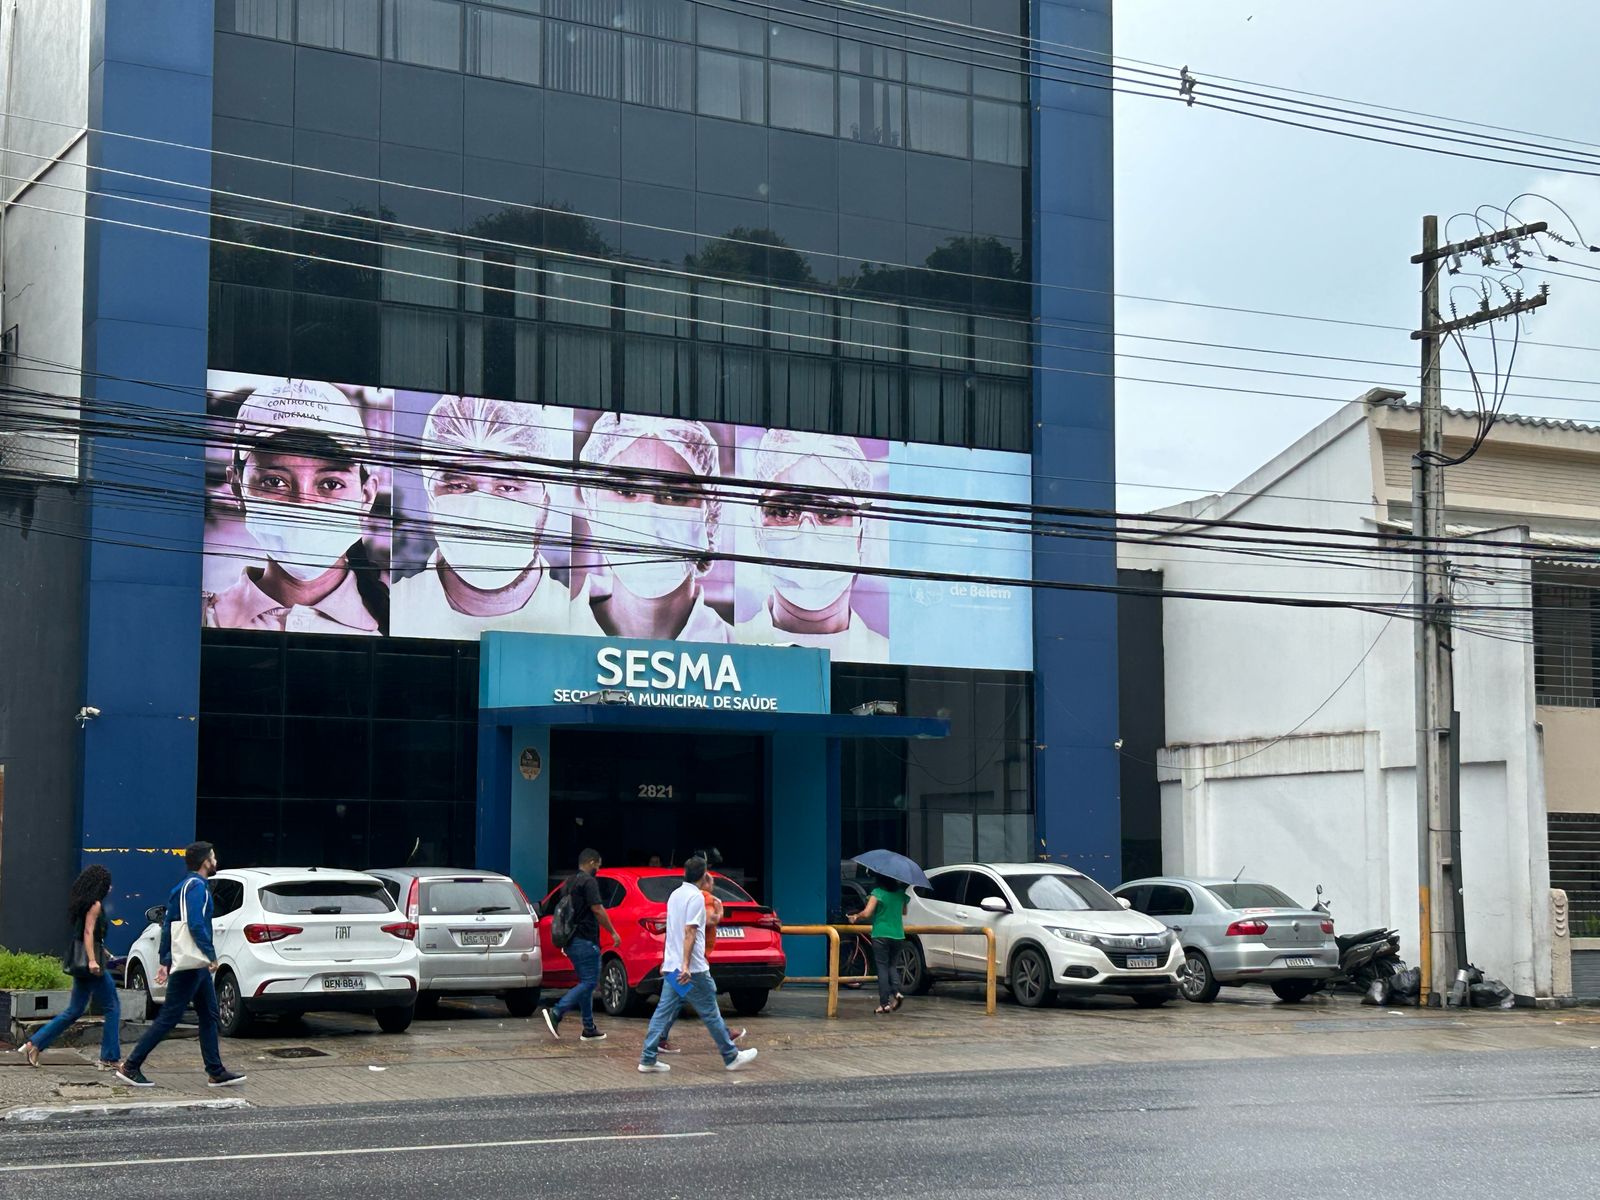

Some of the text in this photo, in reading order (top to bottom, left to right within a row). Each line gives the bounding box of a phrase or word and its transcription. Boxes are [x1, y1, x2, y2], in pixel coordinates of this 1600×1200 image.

[596, 647, 742, 692] SESMA
[638, 693, 708, 708] MUNICIPAL
[713, 696, 731, 709] DE
[733, 694, 778, 710] SAÚDE
[638, 784, 673, 798] 2821
[335, 926, 351, 940] FIAT
